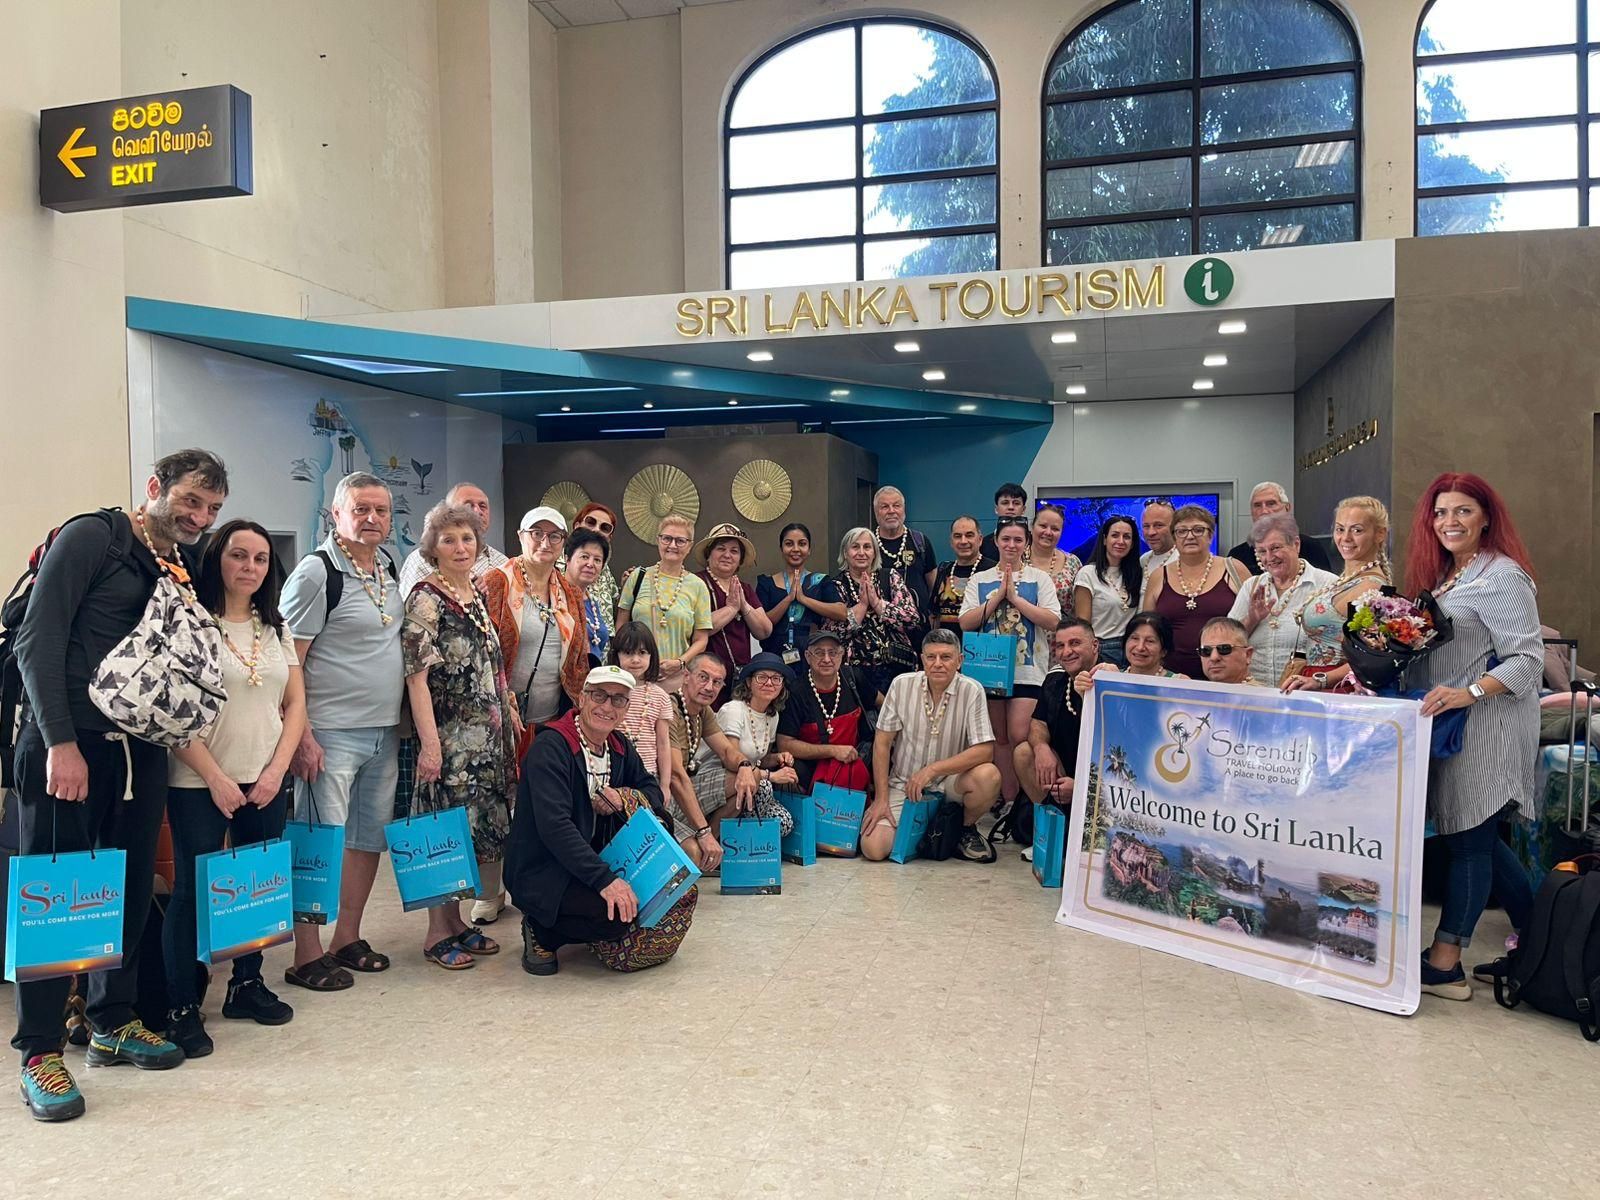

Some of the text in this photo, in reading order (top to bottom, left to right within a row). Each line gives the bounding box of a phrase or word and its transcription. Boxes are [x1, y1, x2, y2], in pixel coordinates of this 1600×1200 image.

[112, 124, 212, 158] வெளியேறல்
[112, 162, 157, 186] EXIT
[676, 296, 748, 337] SRI
[764, 285, 919, 332] LANKA
[929, 264, 1166, 321] TOURISM
[1224, 767, 1231, 776] A
[1233, 768, 1254, 778] place
[1268, 775, 1278, 784] go
[1281, 776, 1300, 786] back
[1225, 757, 1301, 776] TRAVEL HOLIDAYS
[1109, 784, 1383, 860] Welcome to Sri Lanka
[292, 848, 328, 871] Lanka
[391, 835, 462, 865] Sri Lanka
[627, 832, 658, 864] Lanka
[722, 837, 777, 857] Sri Lanka
[20, 879, 120, 915] Sri Lanka
[211, 871, 288, 906] Sri Lanka
[22, 919, 45, 927] YOU'LL
[48, 916, 67, 924] COME
[69, 914, 86, 922] BACK
[102, 910, 119, 918] MORE
